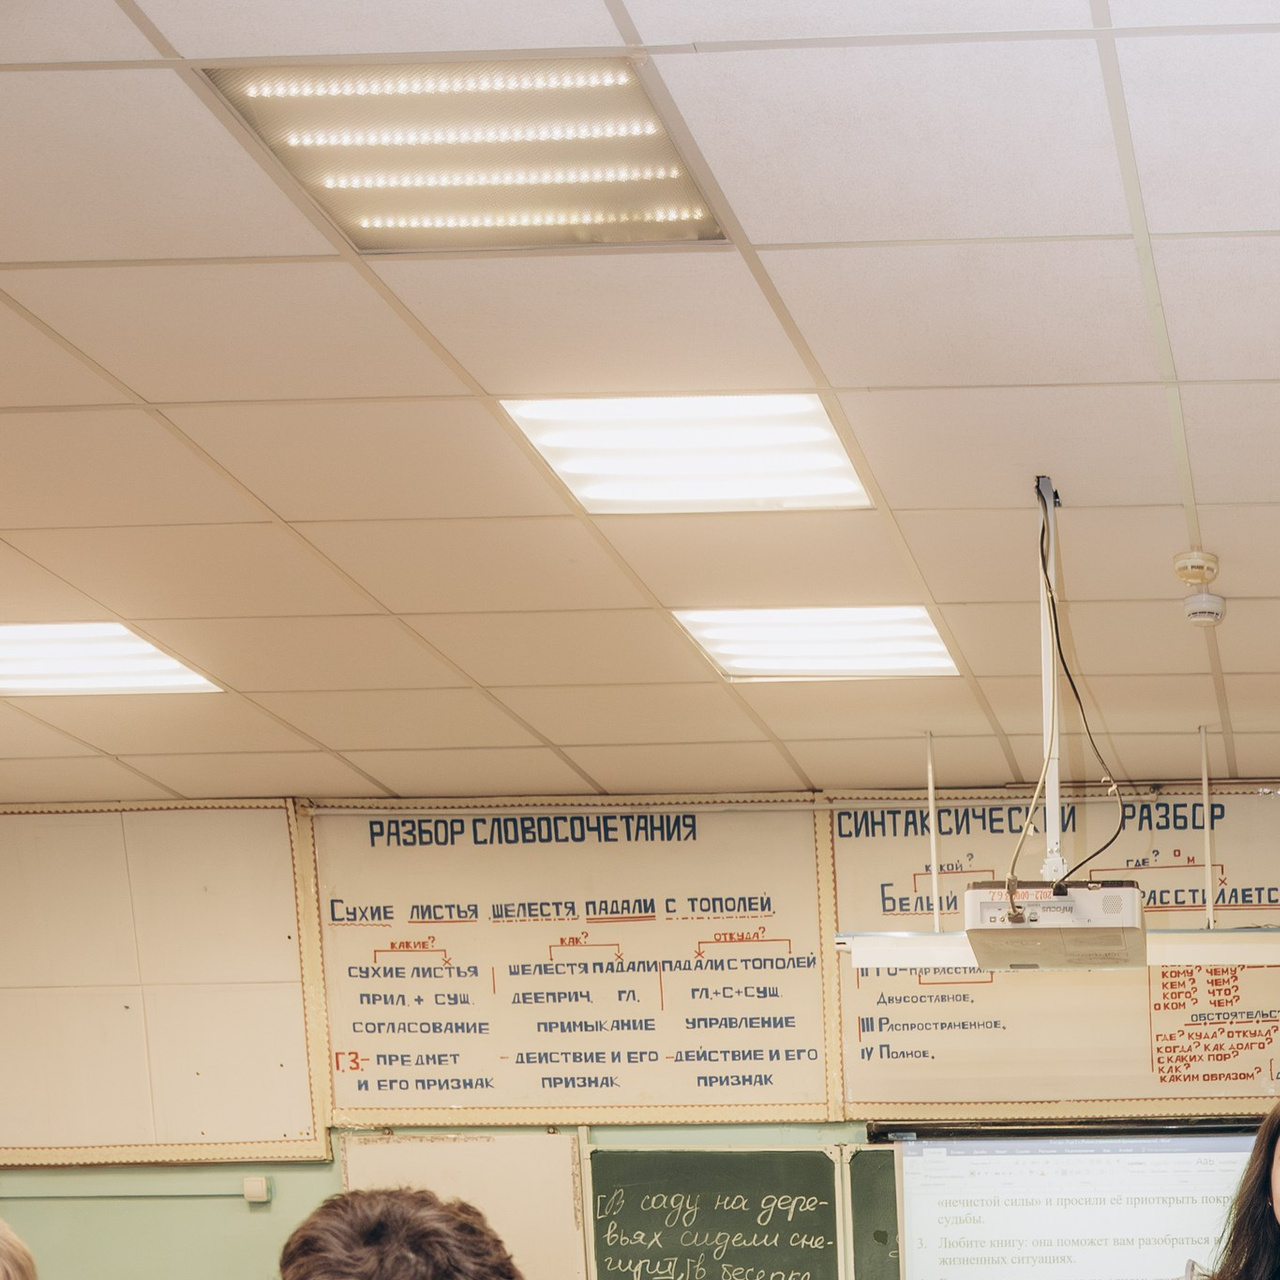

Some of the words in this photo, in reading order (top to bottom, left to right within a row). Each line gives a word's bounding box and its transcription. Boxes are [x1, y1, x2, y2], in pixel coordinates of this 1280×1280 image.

[837, 803, 1076, 838] СИНТАКСИЧЕСКЙ
[1122, 803, 1225, 831] РАЗБОР
[370, 818, 465, 847] РАЗБОР
[472, 814, 697, 845] СЛОВОСОЧЕТАНИЯ
[925, 853, 974, 872] ККОЙ?
[586, 899, 655, 916] ПАДАЛИ
[666, 898, 677, 914] С
[509, 962, 589, 976] ШЕЛЕСТЯ
[593, 960, 658, 974] ПАДАЛИ
[662, 959, 724, 972] ПАДАЛИ
[727, 958, 739, 971] С
[740, 952, 816, 970] ТОПОЛЕЙ
[348, 966, 406, 979] СУХИЕ
[411, 965, 479, 978] ЛИСТЬЯ
[352, 1021, 490, 1034] СОГЛАСОВАНИЕ
[537, 1018, 656, 1033] ПРИМЫКАНИЕ
[685, 1016, 796, 1030] УПРАВЛЕНИЕ
[1203, 1043, 1225, 1052] КАК
[376, 1053, 460, 1066] ПРЕДМЕТ
[611, 1051, 621, 1063] И
[627, 1051, 659, 1063] ЕГО
[769, 1050, 780, 1061] И
[785, 1049, 818, 1061] ЕГО
[357, 1079, 369, 1091] И
[377, 1079, 409, 1091] ЕГО
[415, 1078, 495, 1090] ПРИЗНАК
[541, 1076, 621, 1089] ПРИЗНАК
[697, 1074, 774, 1087] ПРИЗНАК
[1159, 1074, 1199, 1083] КАКИМ
[641, 1192, 701, 1228] саду
[714, 1195, 750, 1212] на
[602, 1221, 663, 1249] вьях
[680, 1230, 779, 1261] сидели
